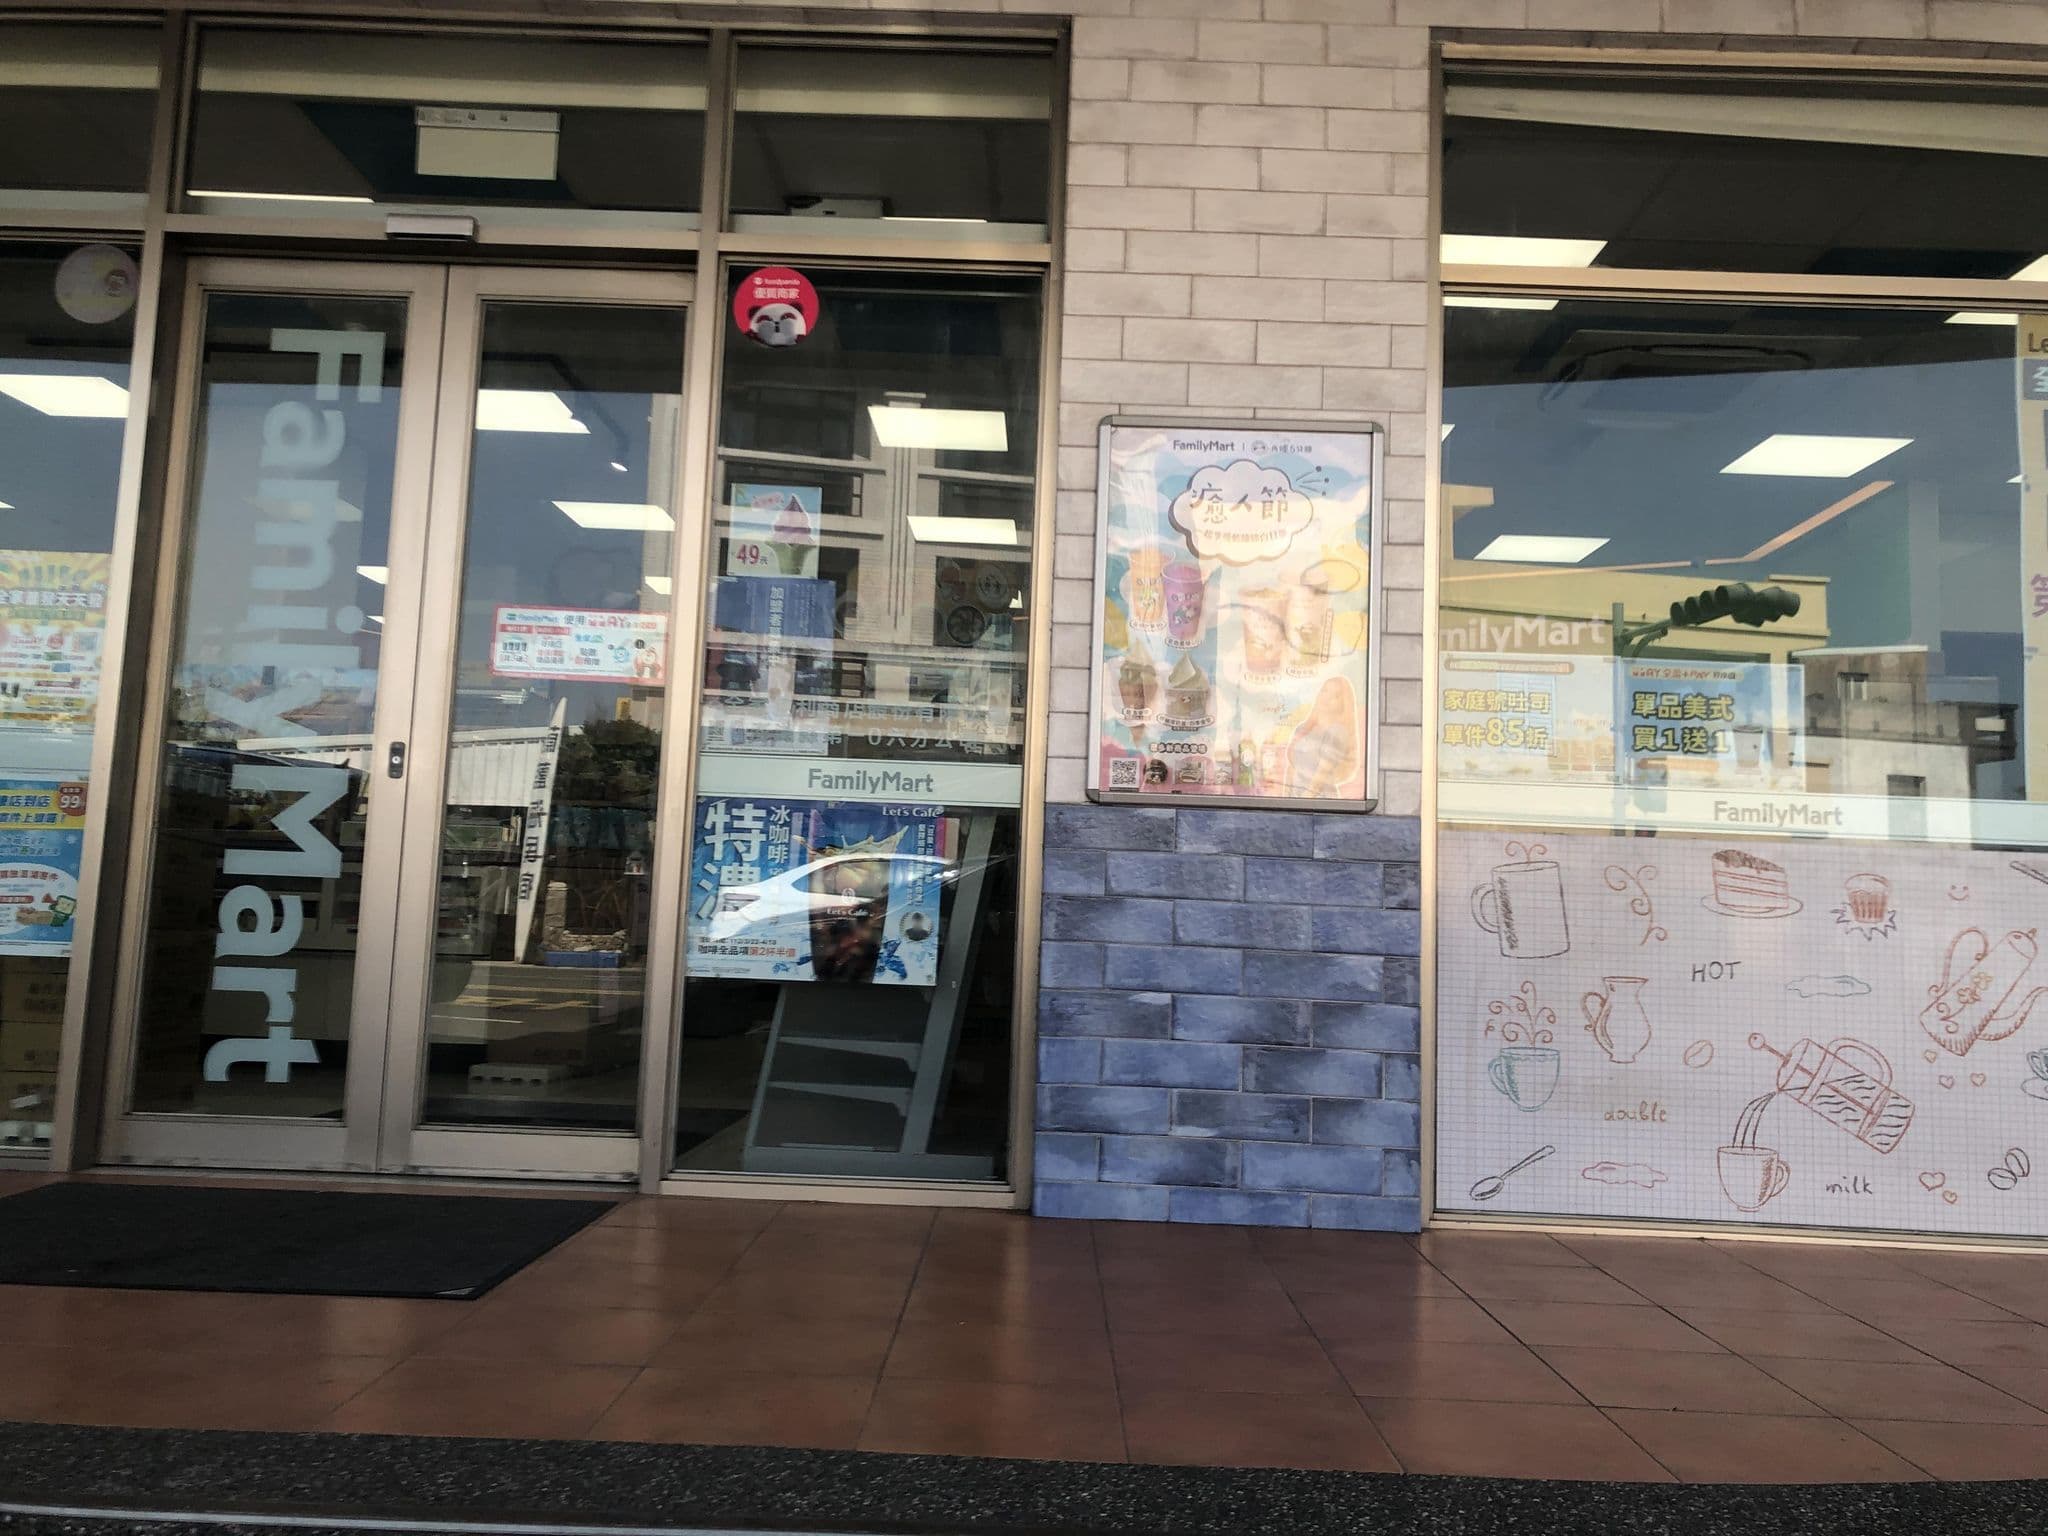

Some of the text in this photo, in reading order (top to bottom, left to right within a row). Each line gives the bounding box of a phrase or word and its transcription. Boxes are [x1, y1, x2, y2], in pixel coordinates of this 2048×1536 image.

[1172, 439, 1235, 453] FamilyMart
[1443, 688, 1551, 714] 家庭號吐司
[1633, 691, 1734, 721] 單品美式
[1443, 717, 1549, 750] 單件85折
[1633, 726, 1730, 754] 買1送1
[808, 767, 935, 795] FamilyMart
[59, 795, 82, 809] 99
[881, 806, 910, 817] Let's
[1713, 800, 1844, 829] FamilyMart
[768, 804, 792, 864] 冰咖啡
[1691, 960, 1743, 983] HOT
[1826, 1174, 1874, 1195] milk
